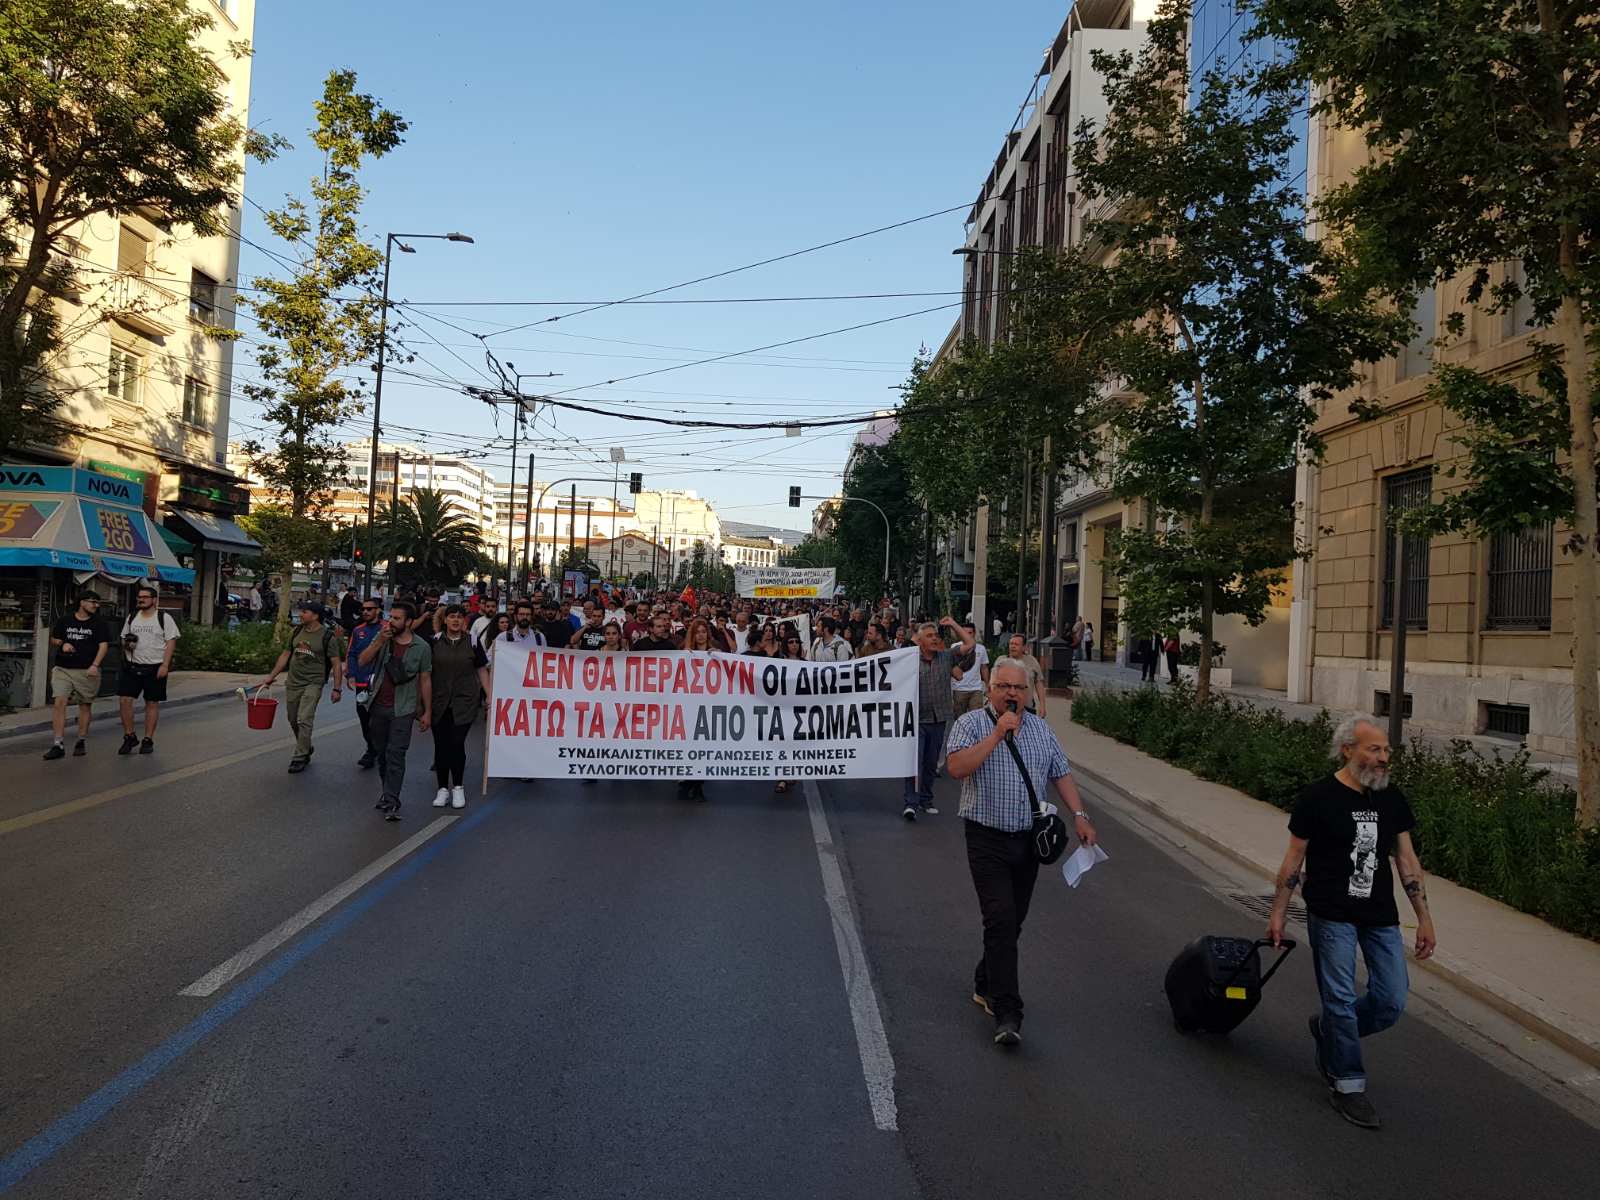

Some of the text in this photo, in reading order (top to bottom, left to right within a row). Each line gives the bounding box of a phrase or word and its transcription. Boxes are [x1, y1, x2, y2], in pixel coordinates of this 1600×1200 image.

[88, 478, 130, 499] NOVA
[97, 508, 131, 532] FREE
[102, 528, 135, 552] 2GO
[522, 651, 892, 696] ΔΕΝ ΘΑ ΠΕΡΑΣΟΥΝ ΟΙ ΔΙΩΞΕΙΣ
[494, 697, 915, 742] ΚΑΤΩ ΤΑ ΧΕΡΙΑ ΑΠΟ ΤΑ ΣΩΜΑΤΕΙΑ
[558, 747, 857, 761] ΣΥΝΔΙΚΑΛΙΣΤΙΚΕΣ ΟΡΓΑΝΩΣΕΙΣ & ΚΙΝΗΣΕΙΣ
[568, 764, 694, 776] ΣΥΛΛΟΓΙΚΟΤΗΤΕΣ
[706, 766, 771, 776] ΚΙΝΗΣΕΙΣ
[775, 764, 846, 776] ΓΕΙΤΟΝΙΑΣ
